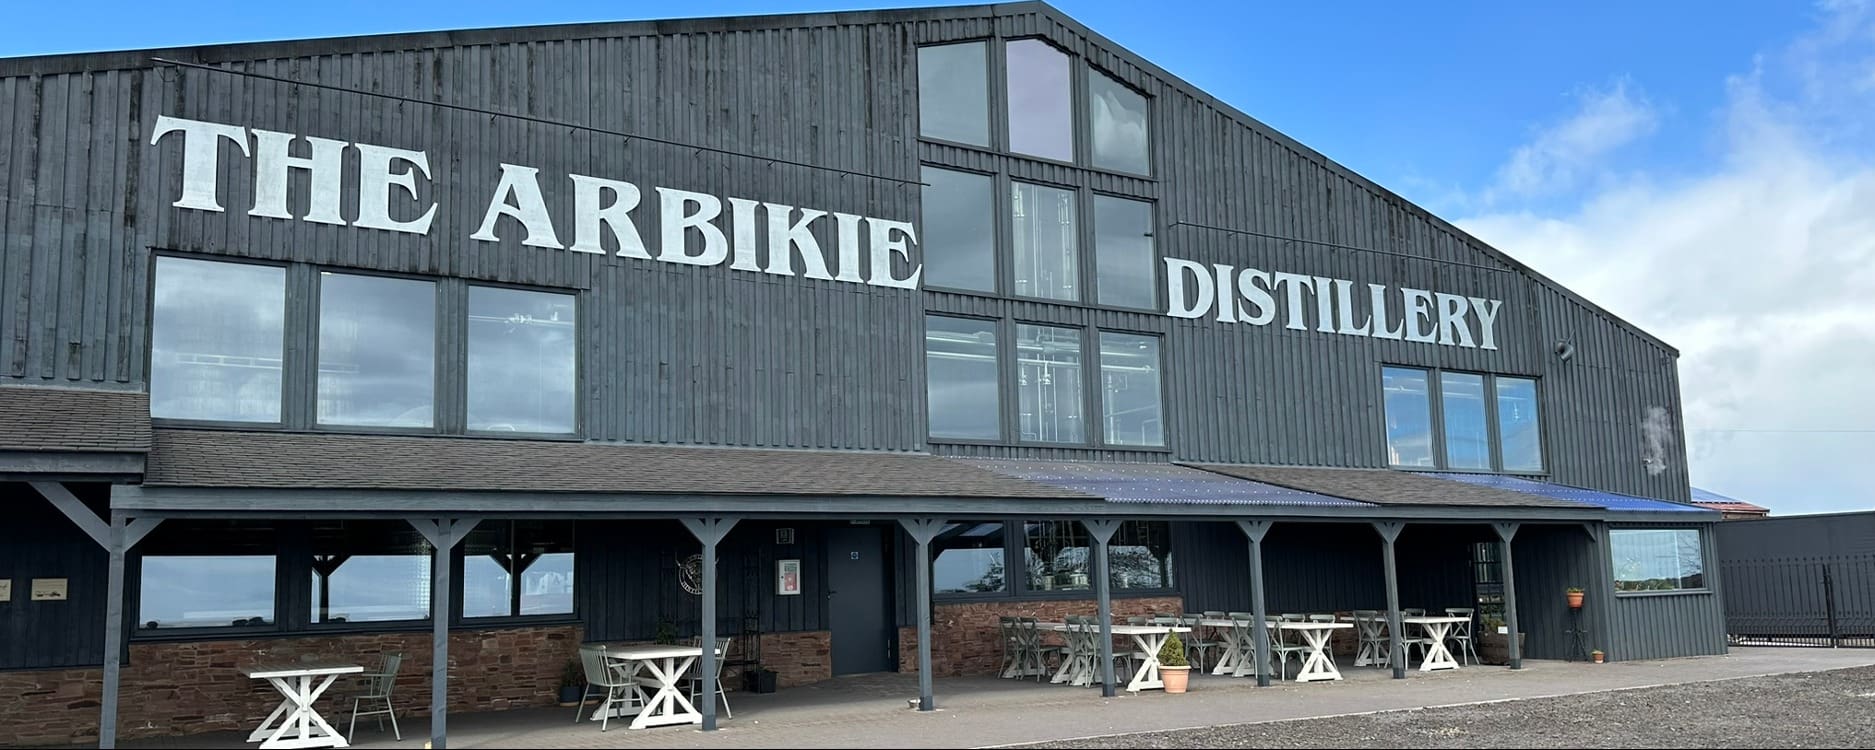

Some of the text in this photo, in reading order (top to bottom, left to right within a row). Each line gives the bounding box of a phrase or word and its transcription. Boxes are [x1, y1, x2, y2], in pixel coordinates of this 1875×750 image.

[150, 114, 1503, 351] THE ARBIKIE DISTILLERY
